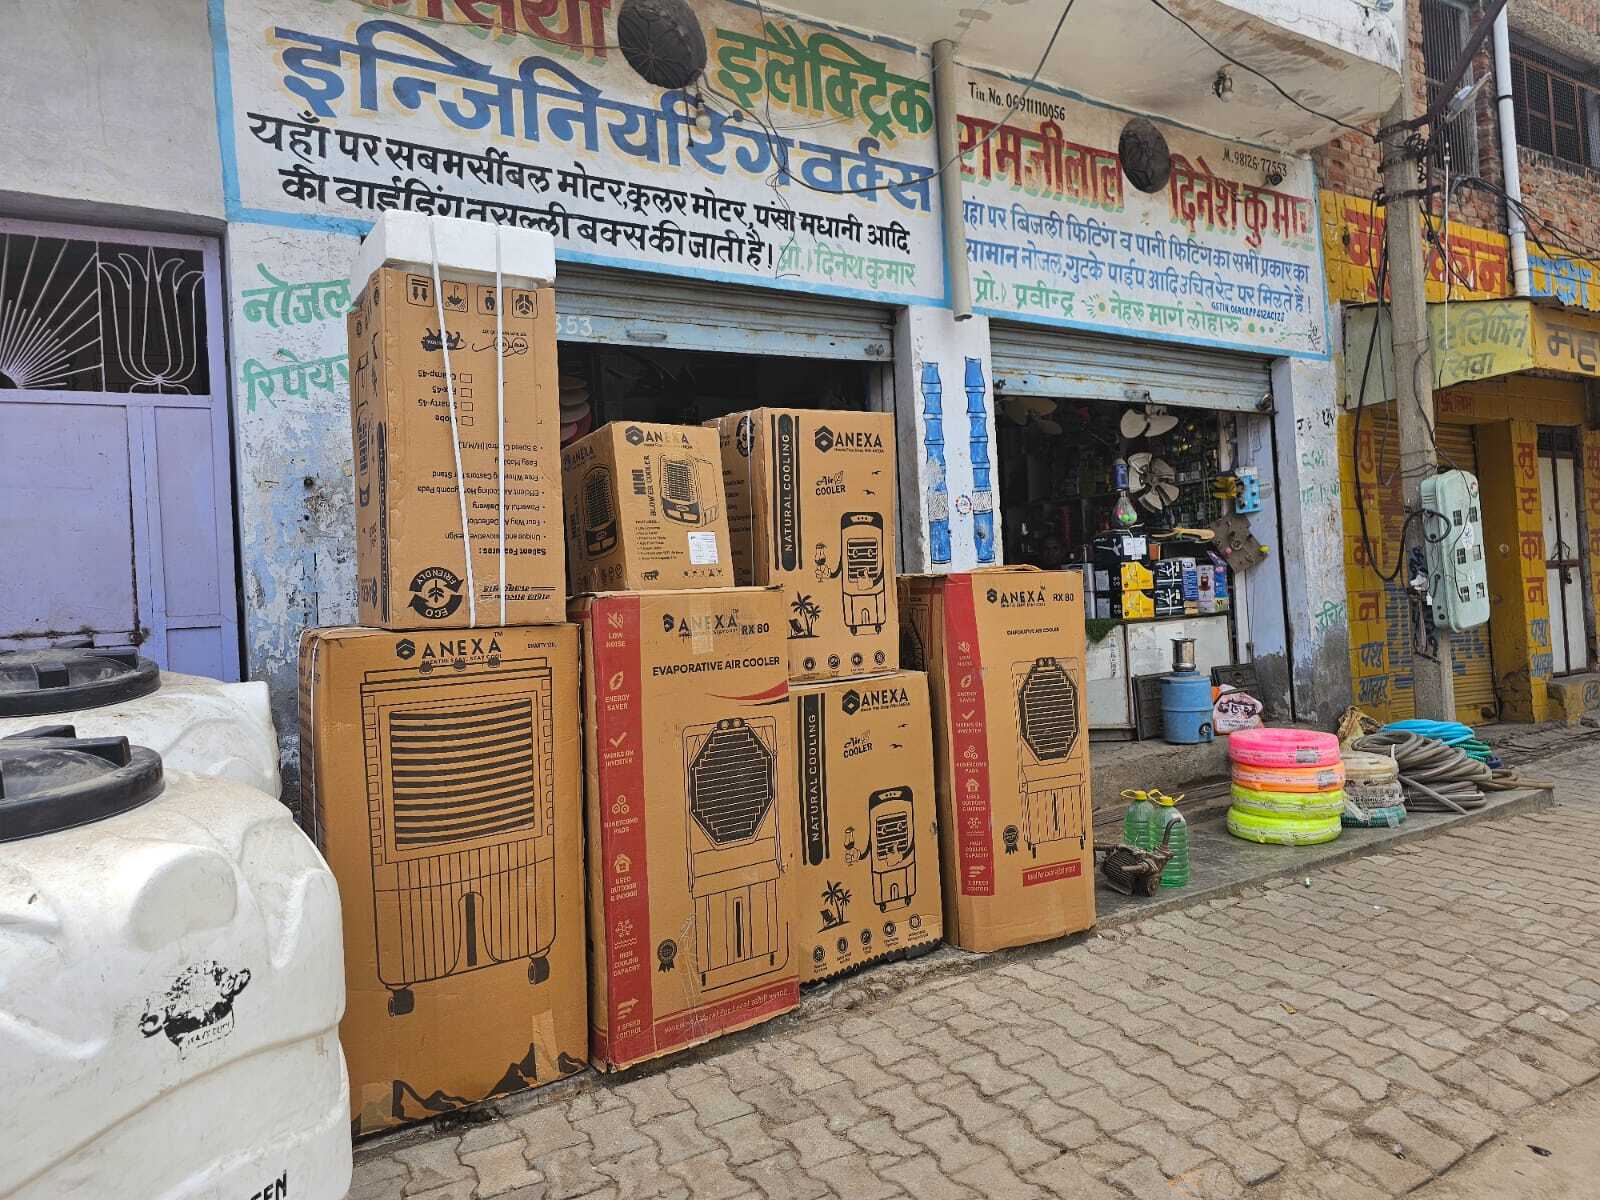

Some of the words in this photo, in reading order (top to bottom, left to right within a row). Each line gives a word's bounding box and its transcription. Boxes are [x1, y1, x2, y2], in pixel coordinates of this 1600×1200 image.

[334, 129, 382, 166] पर
[278, 164, 330, 206] की
[418, 399, 458, 410] Sarty-45
[834, 432, 883, 450] ANEXA
[783, 433, 791, 491] COOLING
[815, 484, 846, 497] COOLER
[783, 496, 793, 553] NATURAL
[416, 565, 458, 586] FRIENDLY
[1000, 590, 1046, 604] ANEXA
[425, 606, 449, 618] ECO
[756, 622, 770, 634] 80
[421, 638, 502, 660] ANEXA
[652, 659, 724, 677] EVAPORATIVE
[724, 658, 742, 670] AIR
[741, 656, 781, 669] COOLER
[861, 687, 910, 707] ANEXA
[808, 713, 817, 775] COOLING
[843, 742, 874, 759] COOLER
[811, 777, 820, 842] NATURAL
